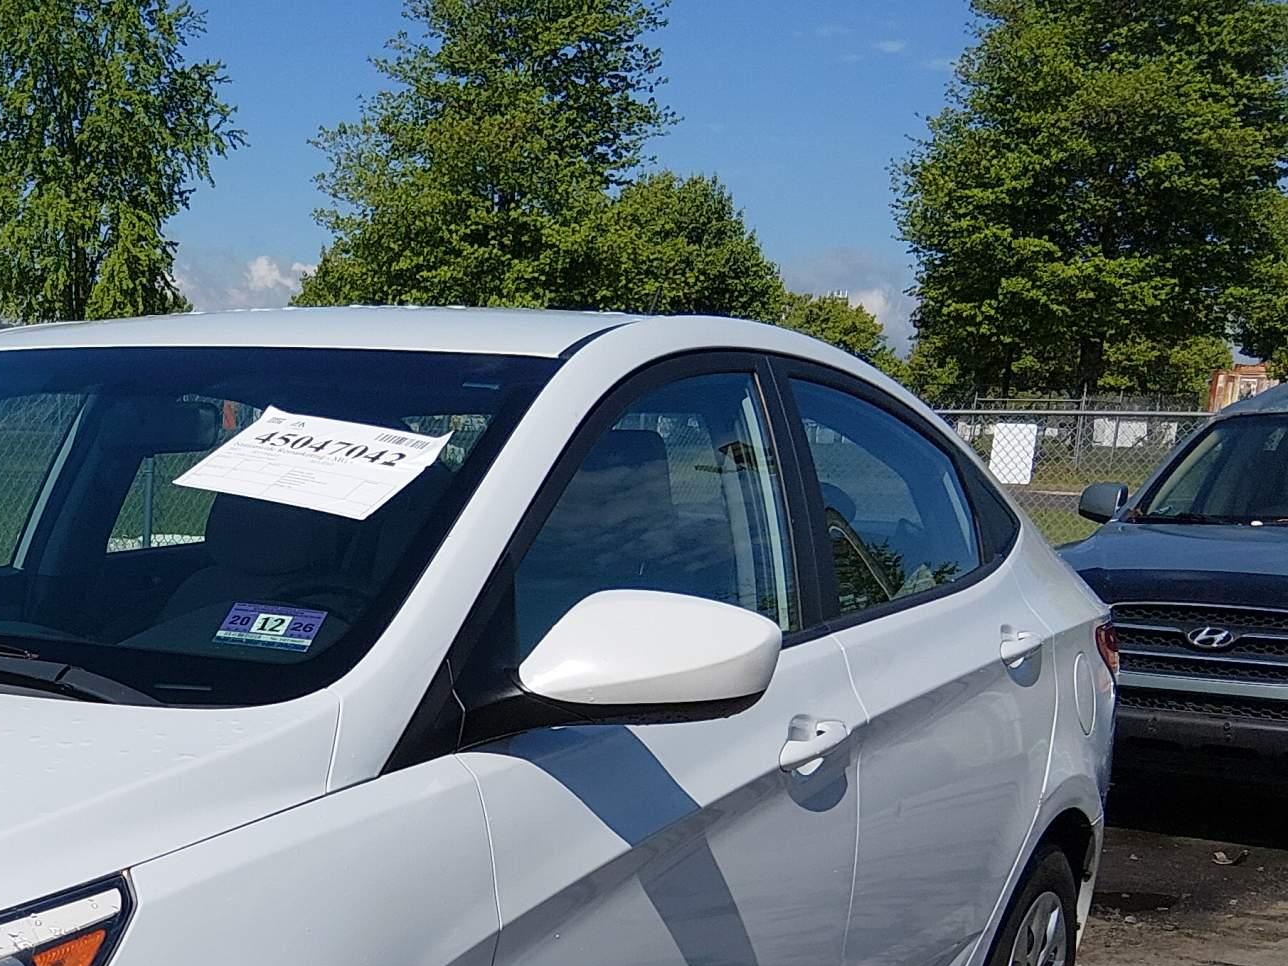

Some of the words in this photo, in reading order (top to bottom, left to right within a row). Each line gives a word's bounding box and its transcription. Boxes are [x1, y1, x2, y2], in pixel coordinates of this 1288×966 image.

[255, 431, 407, 467] 45047042
[229, 615, 251, 626] 20
[256, 616, 286, 632] 12
[291, 622, 315, 633] 26
